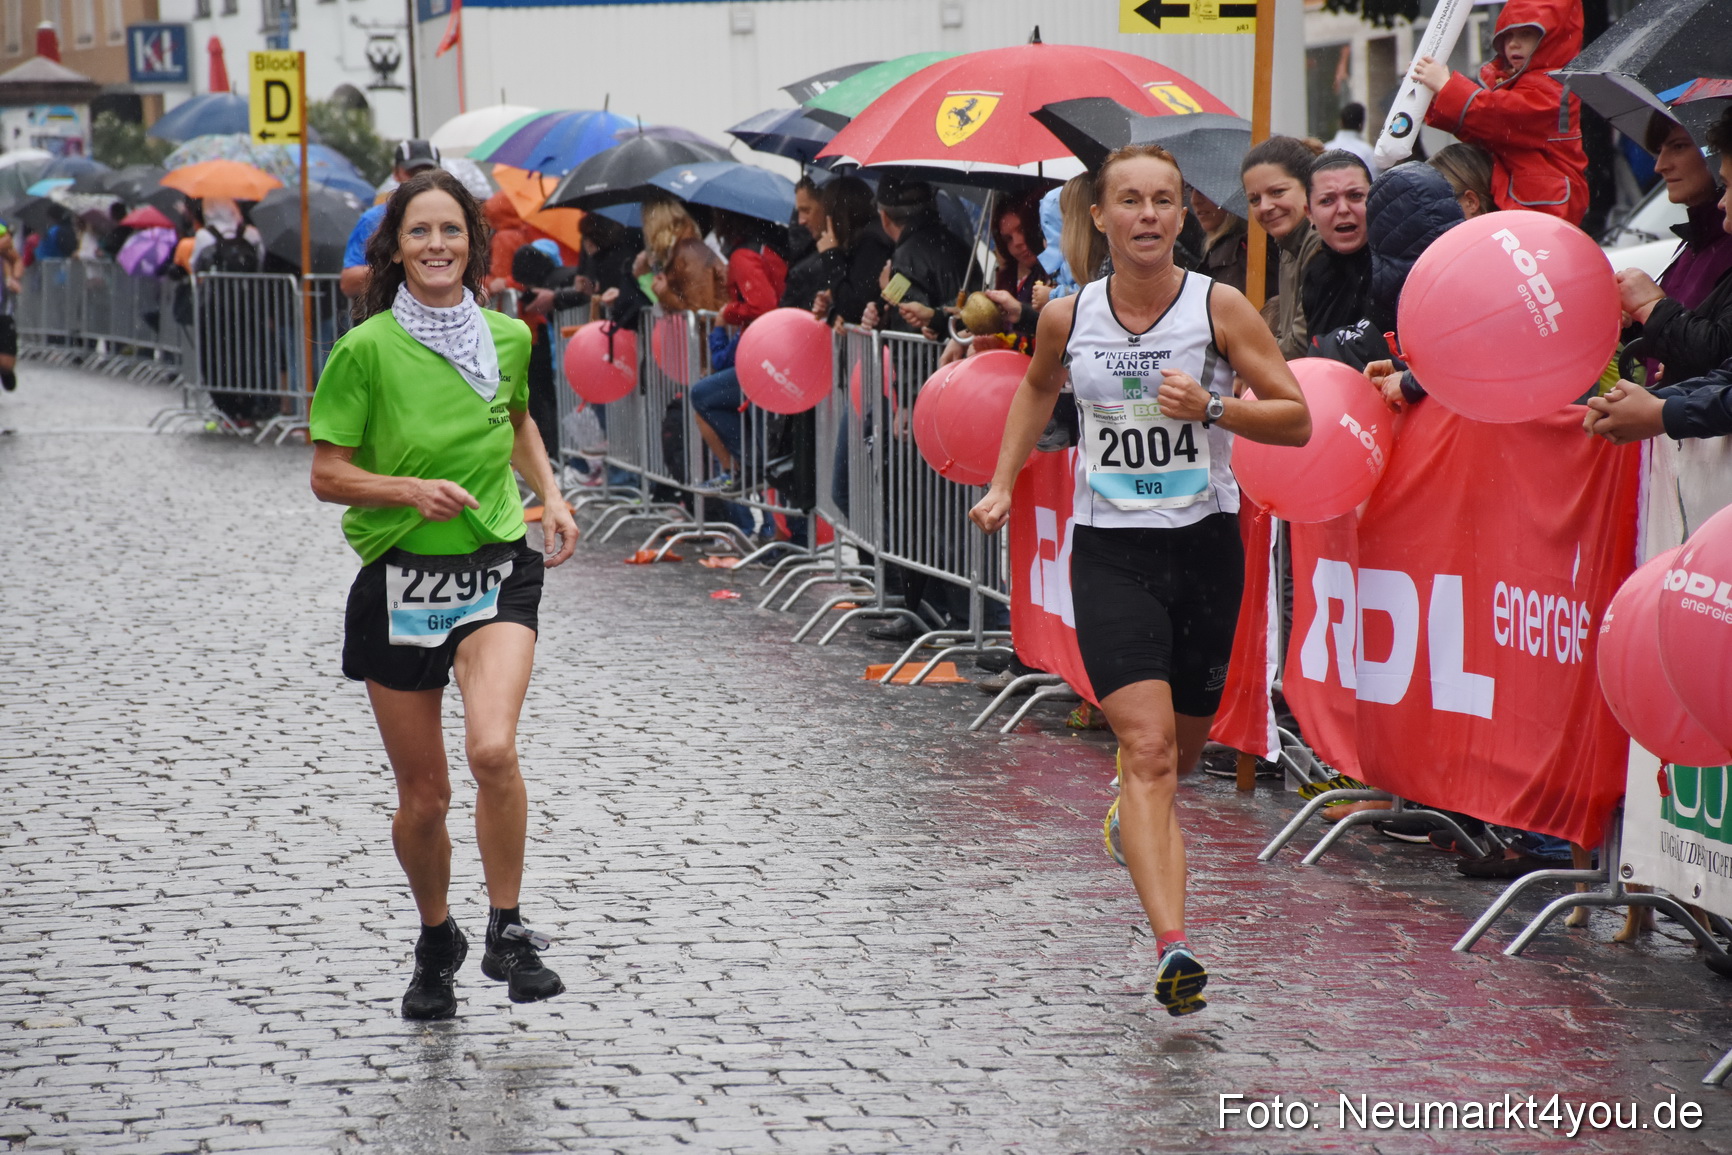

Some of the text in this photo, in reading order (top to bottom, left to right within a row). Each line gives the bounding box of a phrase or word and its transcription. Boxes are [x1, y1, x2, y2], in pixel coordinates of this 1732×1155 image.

[254, 54, 298, 71] Block
[264, 80, 291, 122] D
[1491, 228, 1564, 334] RÖDL
[1104, 350, 1172, 360] INTERSPORT
[1106, 360, 1160, 370] LANGE
[1098, 423, 1199, 469] 2004
[1135, 479, 1163, 495] Eva
[393, 601, 399, 609] B
